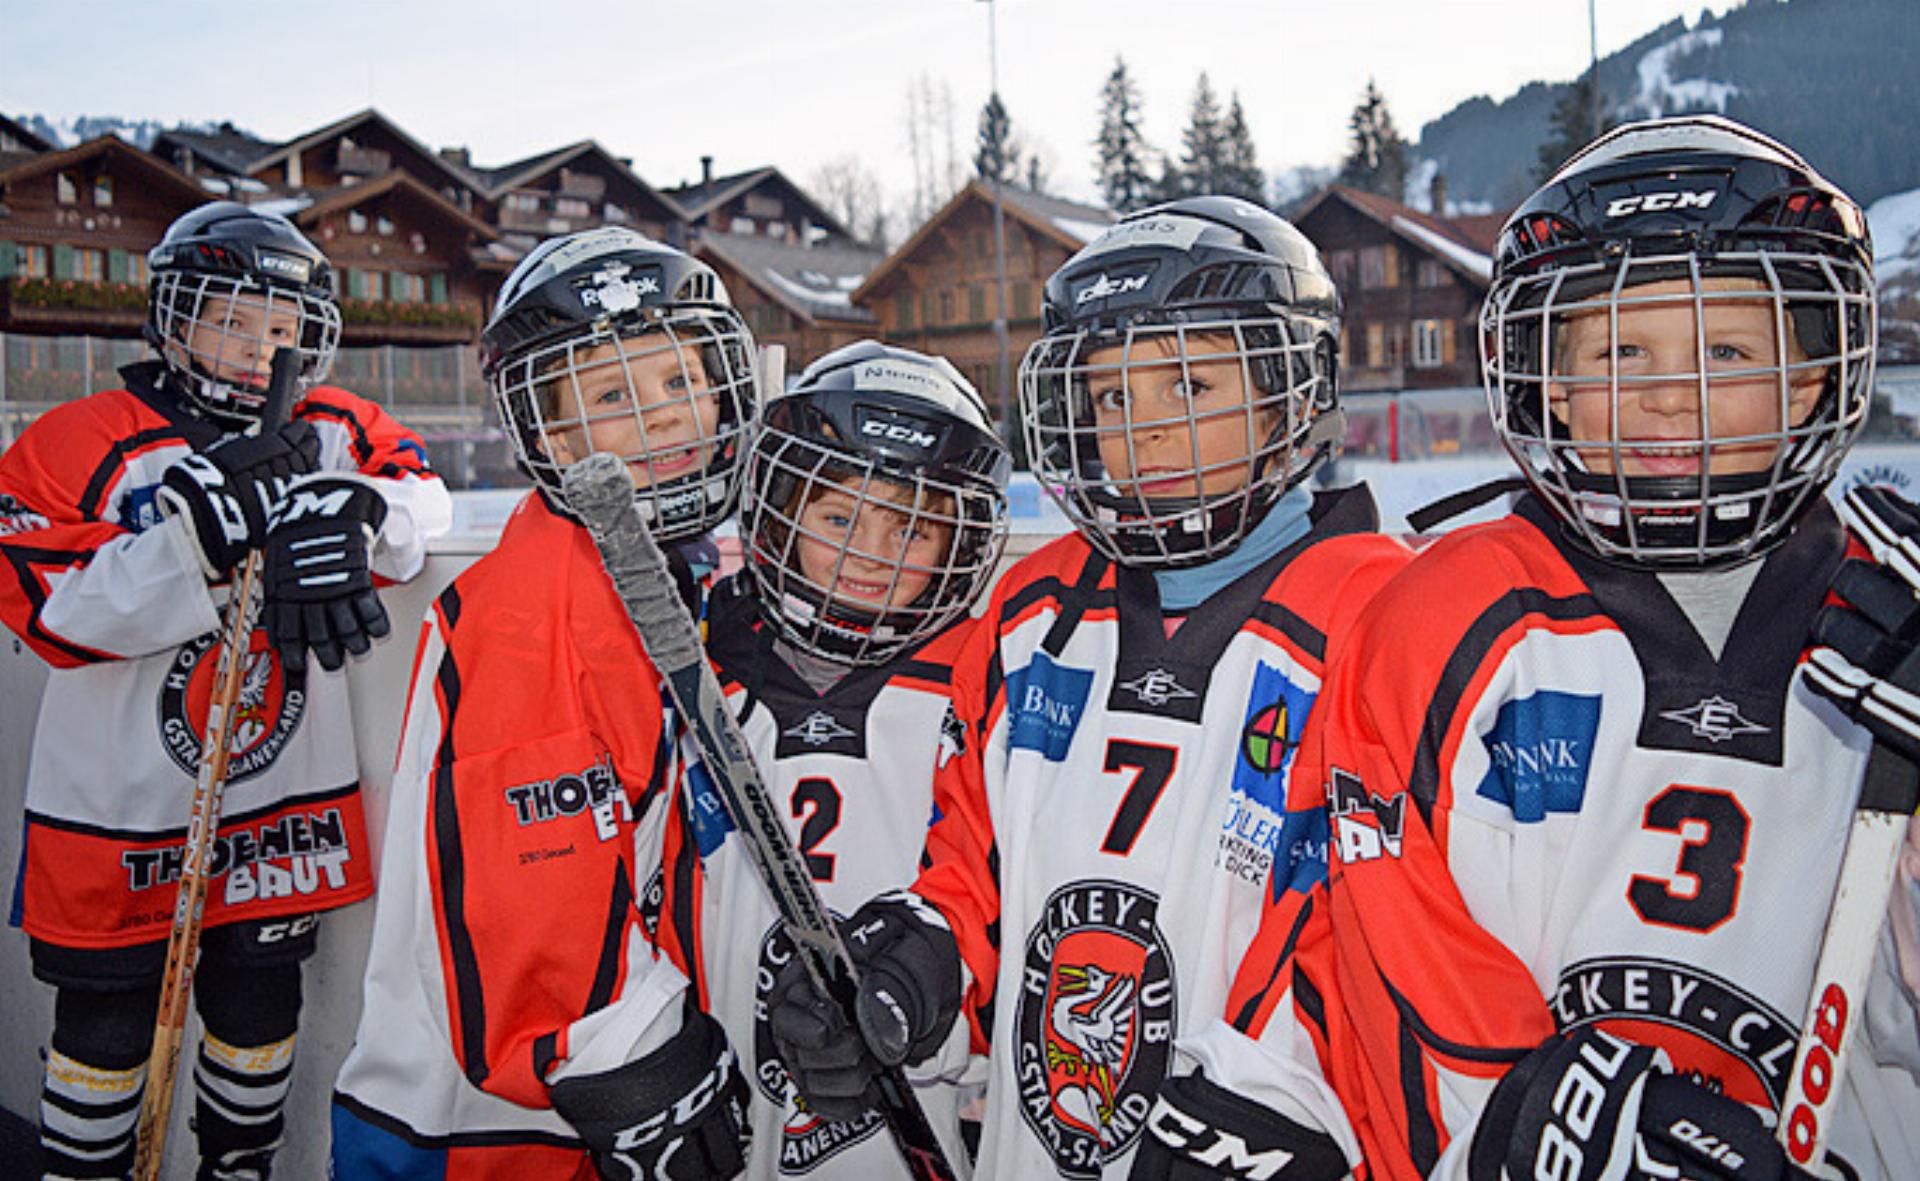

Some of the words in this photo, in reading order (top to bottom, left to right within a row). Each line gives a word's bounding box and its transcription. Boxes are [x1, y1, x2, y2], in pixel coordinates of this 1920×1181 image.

[1606, 189, 1717, 217] CCM
[862, 420, 937, 448] CCM
[789, 776, 844, 883] 2
[1100, 738, 1180, 857] 7
[224, 849, 351, 906] BAUT
[1626, 784, 1751, 935] 3
[257, 912, 319, 943] CC
[1557, 968, 1795, 1077] CKEY-CL
[1147, 1093, 1295, 1181] CM
